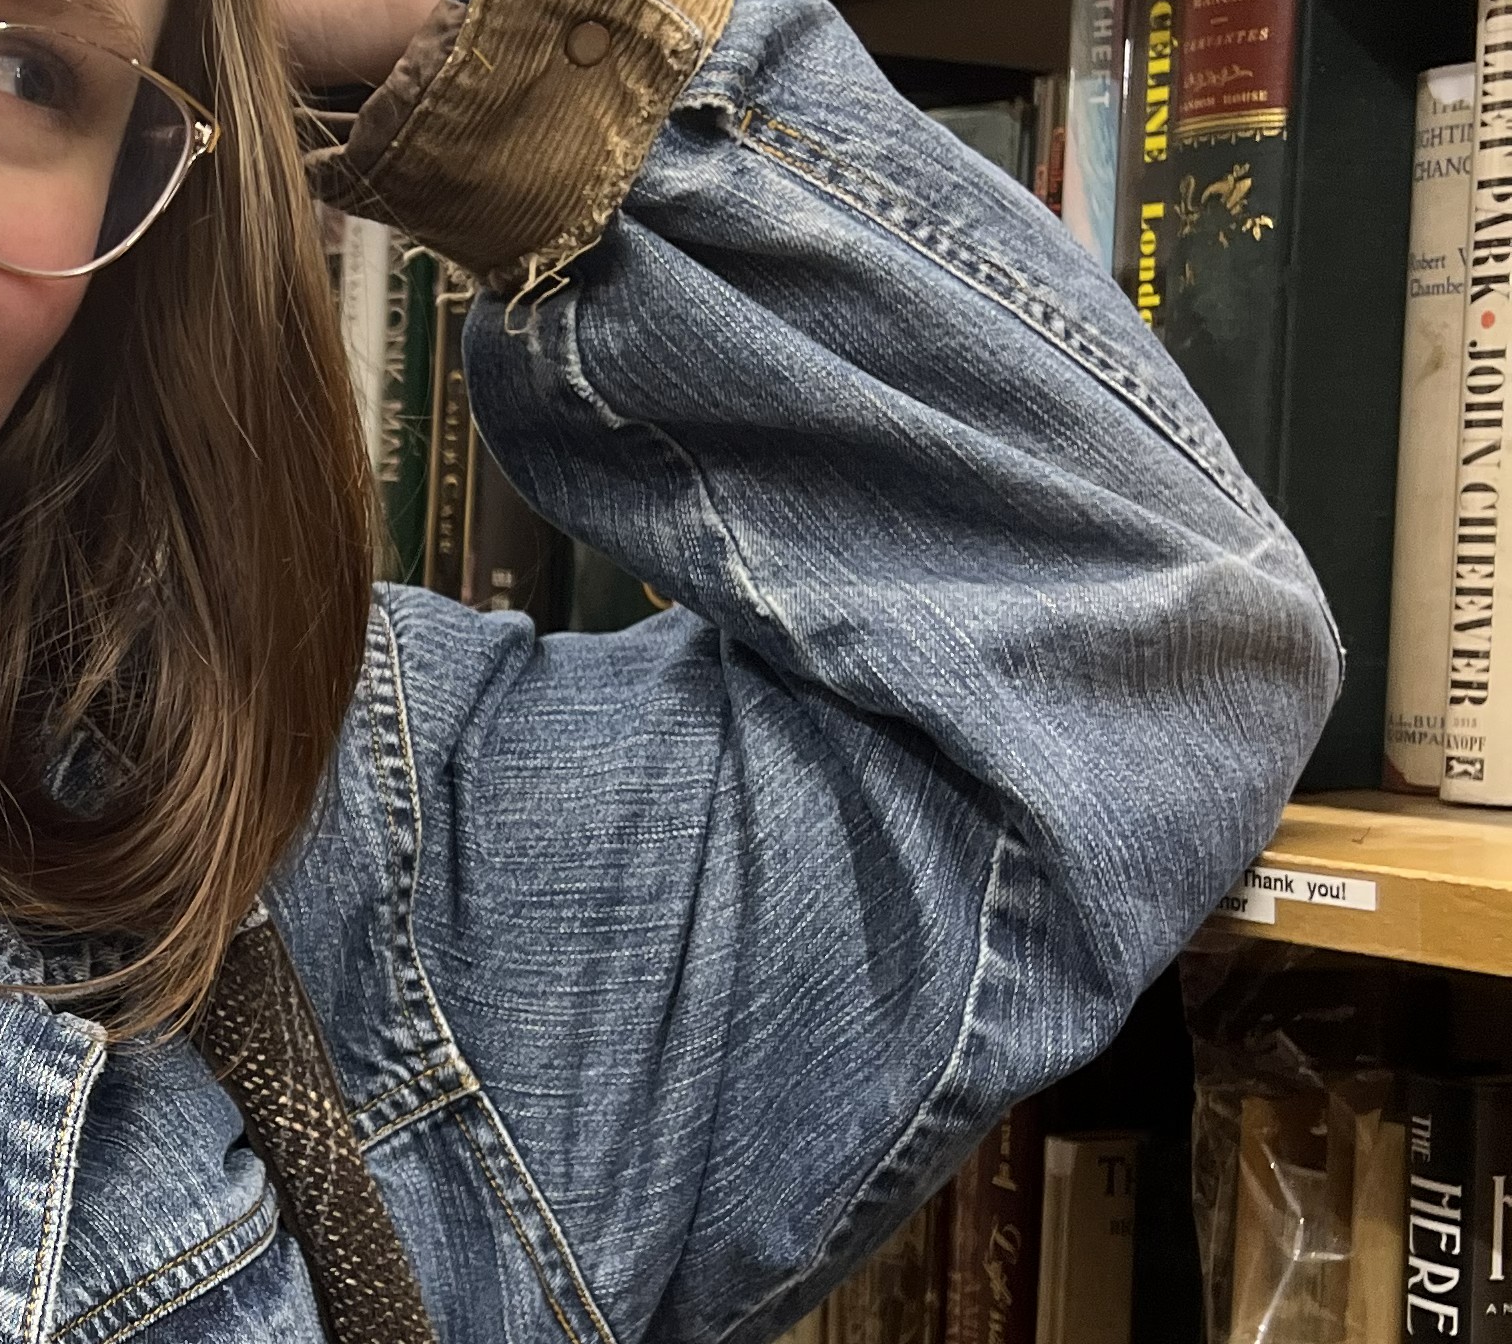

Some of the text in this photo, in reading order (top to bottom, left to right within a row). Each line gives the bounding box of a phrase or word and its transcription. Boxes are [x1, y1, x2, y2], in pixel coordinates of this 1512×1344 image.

[1137, 0, 1178, 330] CÉLINE Londo
[1413, 155, 1471, 182] CHANC
[1469, 177, 1511, 305] PARK
[1410, 275, 1464, 297] Chambe
[381, 398, 402, 484] MAN
[1459, 340, 1508, 482] JOHN
[1450, 483, 1500, 709] CHEEVER
[1244, 869, 1346, 902] Thank you!
[1409, 1114, 1432, 1163] THE
